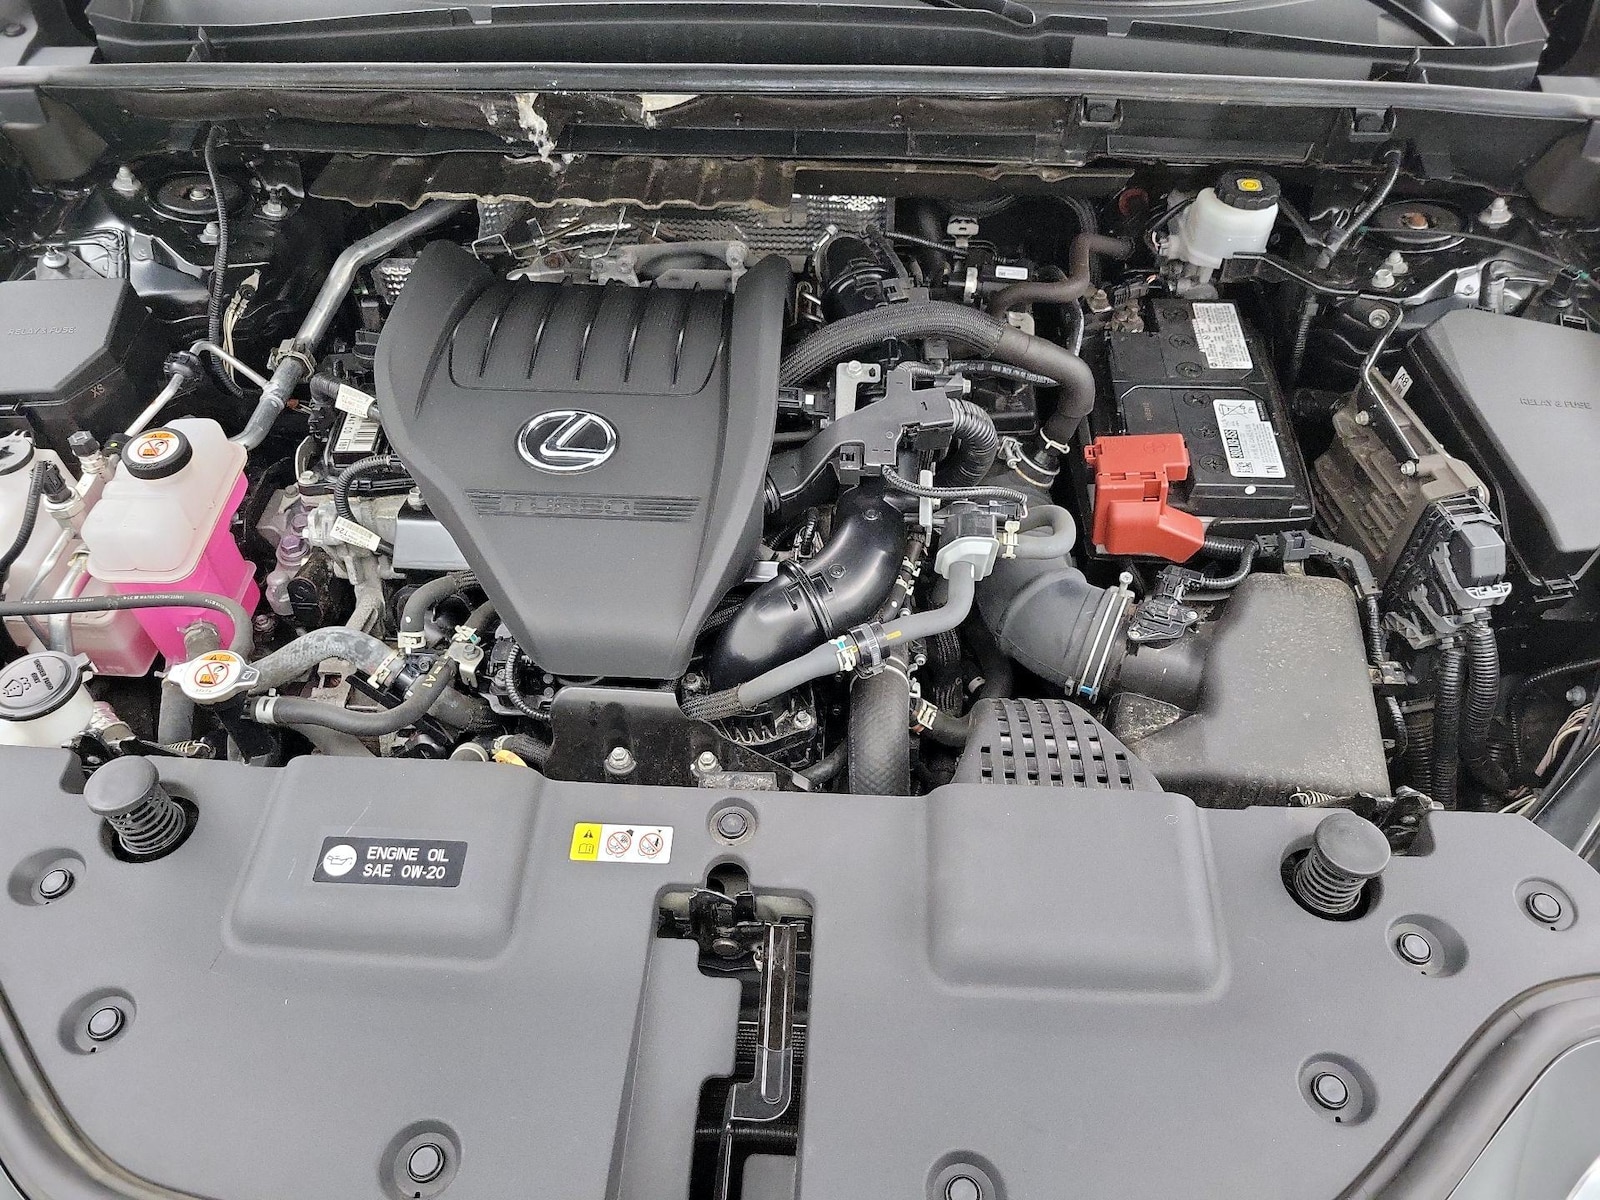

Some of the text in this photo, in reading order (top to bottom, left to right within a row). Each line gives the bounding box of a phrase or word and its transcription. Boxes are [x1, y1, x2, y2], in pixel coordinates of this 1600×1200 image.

[8, 327, 41, 336] RELAY
[49, 326, 77, 334] FUSE
[1520, 397, 1552, 407] RELAY
[1564, 400, 1593, 410] FUSE
[504, 496, 632, 516] TURBO
[367, 846, 450, 862] ENGINE OIL
[362, 864, 446, 880] SAE 0W-20
